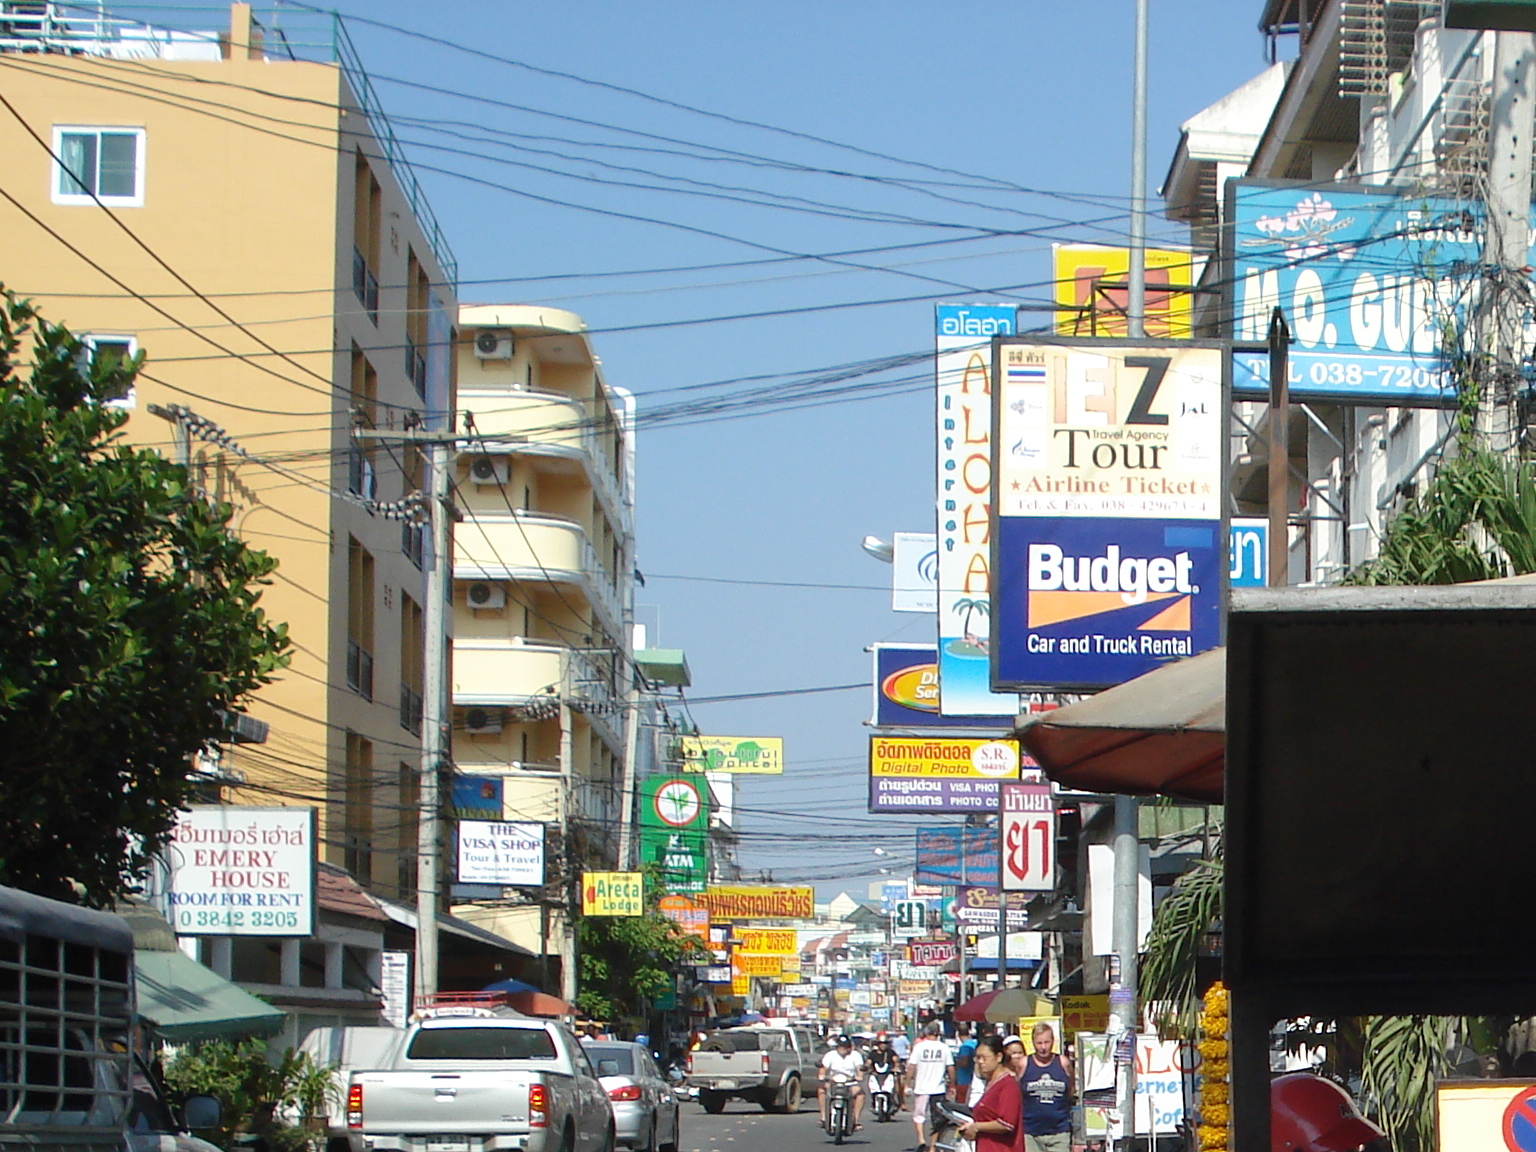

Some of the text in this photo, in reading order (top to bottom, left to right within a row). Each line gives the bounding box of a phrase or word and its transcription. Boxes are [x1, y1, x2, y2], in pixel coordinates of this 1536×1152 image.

[942, 311, 1011, 336] อโลฮา
[1247, 359, 1303, 383] TL
[1053, 354, 1173, 426] EZ
[1092, 429, 1169, 442] Travel Agency
[1053, 428, 1169, 470] Tour
[943, 394, 957, 552] Internet
[960, 352, 993, 594] ALOHA
[1025, 475, 1198, 495] Airline Ticket
[1028, 543, 1194, 605] Budget
[1027, 633, 1193, 656] Car and Truck Rental
[876, 740, 972, 761] อัดภาพดิจิตอล
[980, 748, 1008, 761] S.R.
[881, 762, 969, 775] Digital Photo
[878, 779, 942, 794] ถ่ายรูปด่วน
[950, 782, 972, 793] VISA
[878, 795, 944, 807] ถ่ายเอกสาร
[950, 797, 982, 808] PHOTO
[1004, 787, 1052, 811] บ้านยา
[487, 824, 518, 836] THE
[462, 837, 541, 851] VISA SHOP
[1006, 819, 1049, 882] ยา
[193, 849, 278, 868] EMERY
[463, 851, 491, 863] Tour
[503, 853, 540, 864] Travel
[662, 853, 694, 868] ATM
[211, 870, 290, 889] HOUSE
[596, 879, 640, 898] Areca
[168, 892, 304, 907] ROOM FOR RENT
[602, 898, 639, 913] Lodge
[196, 910, 245, 927] 3842
[251, 911, 298, 928] 3205
[896, 901, 925, 928] ยา
[1063, 1001, 1091, 1009] Kodak
[922, 1048, 943, 1059] CIA
